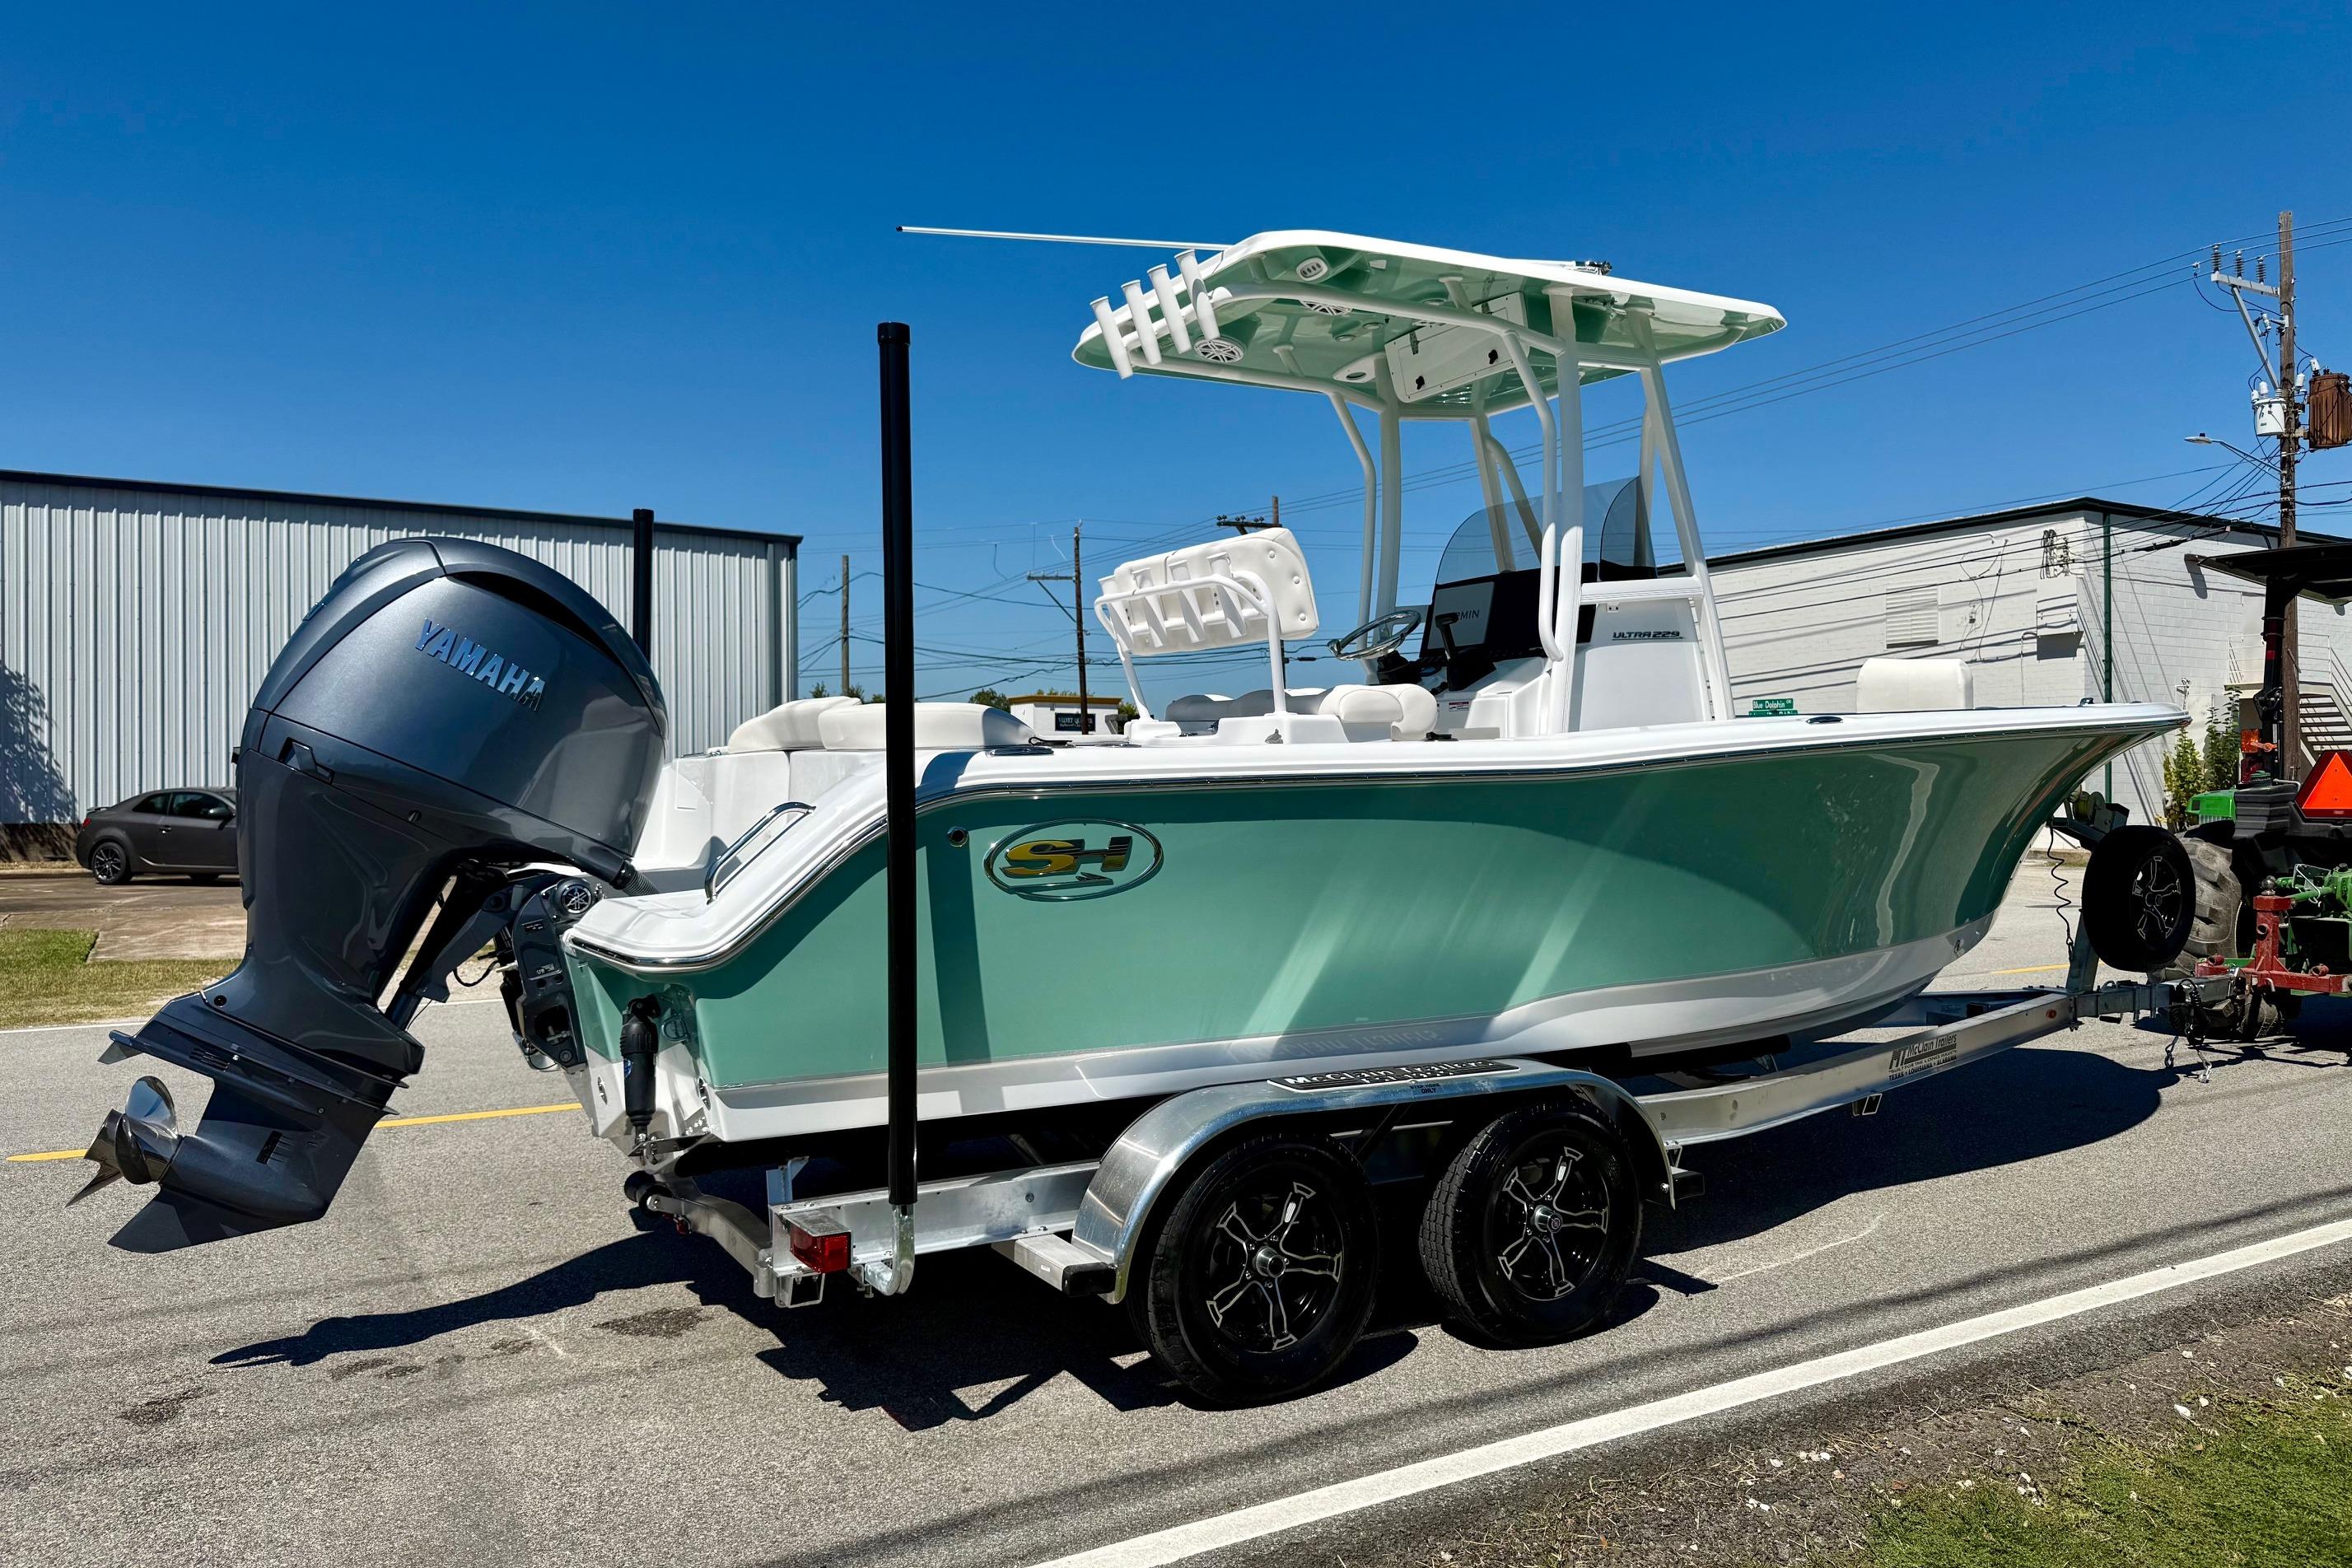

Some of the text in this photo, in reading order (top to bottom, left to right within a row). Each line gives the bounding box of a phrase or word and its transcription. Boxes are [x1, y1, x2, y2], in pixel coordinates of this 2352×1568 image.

[415, 617, 546, 711] YAMAHA
[1752, 701, 1763, 709] Blue
[1765, 700, 1785, 709] Dolphin
[1907, 1034, 1957, 1057] McClain Trailers
[1888, 1055, 1957, 1080] TEXAS LOUISIANA ALABAMA
[1925, 1055, 1940, 1063] LONG
[1284, 1070, 1394, 1085] McClain
